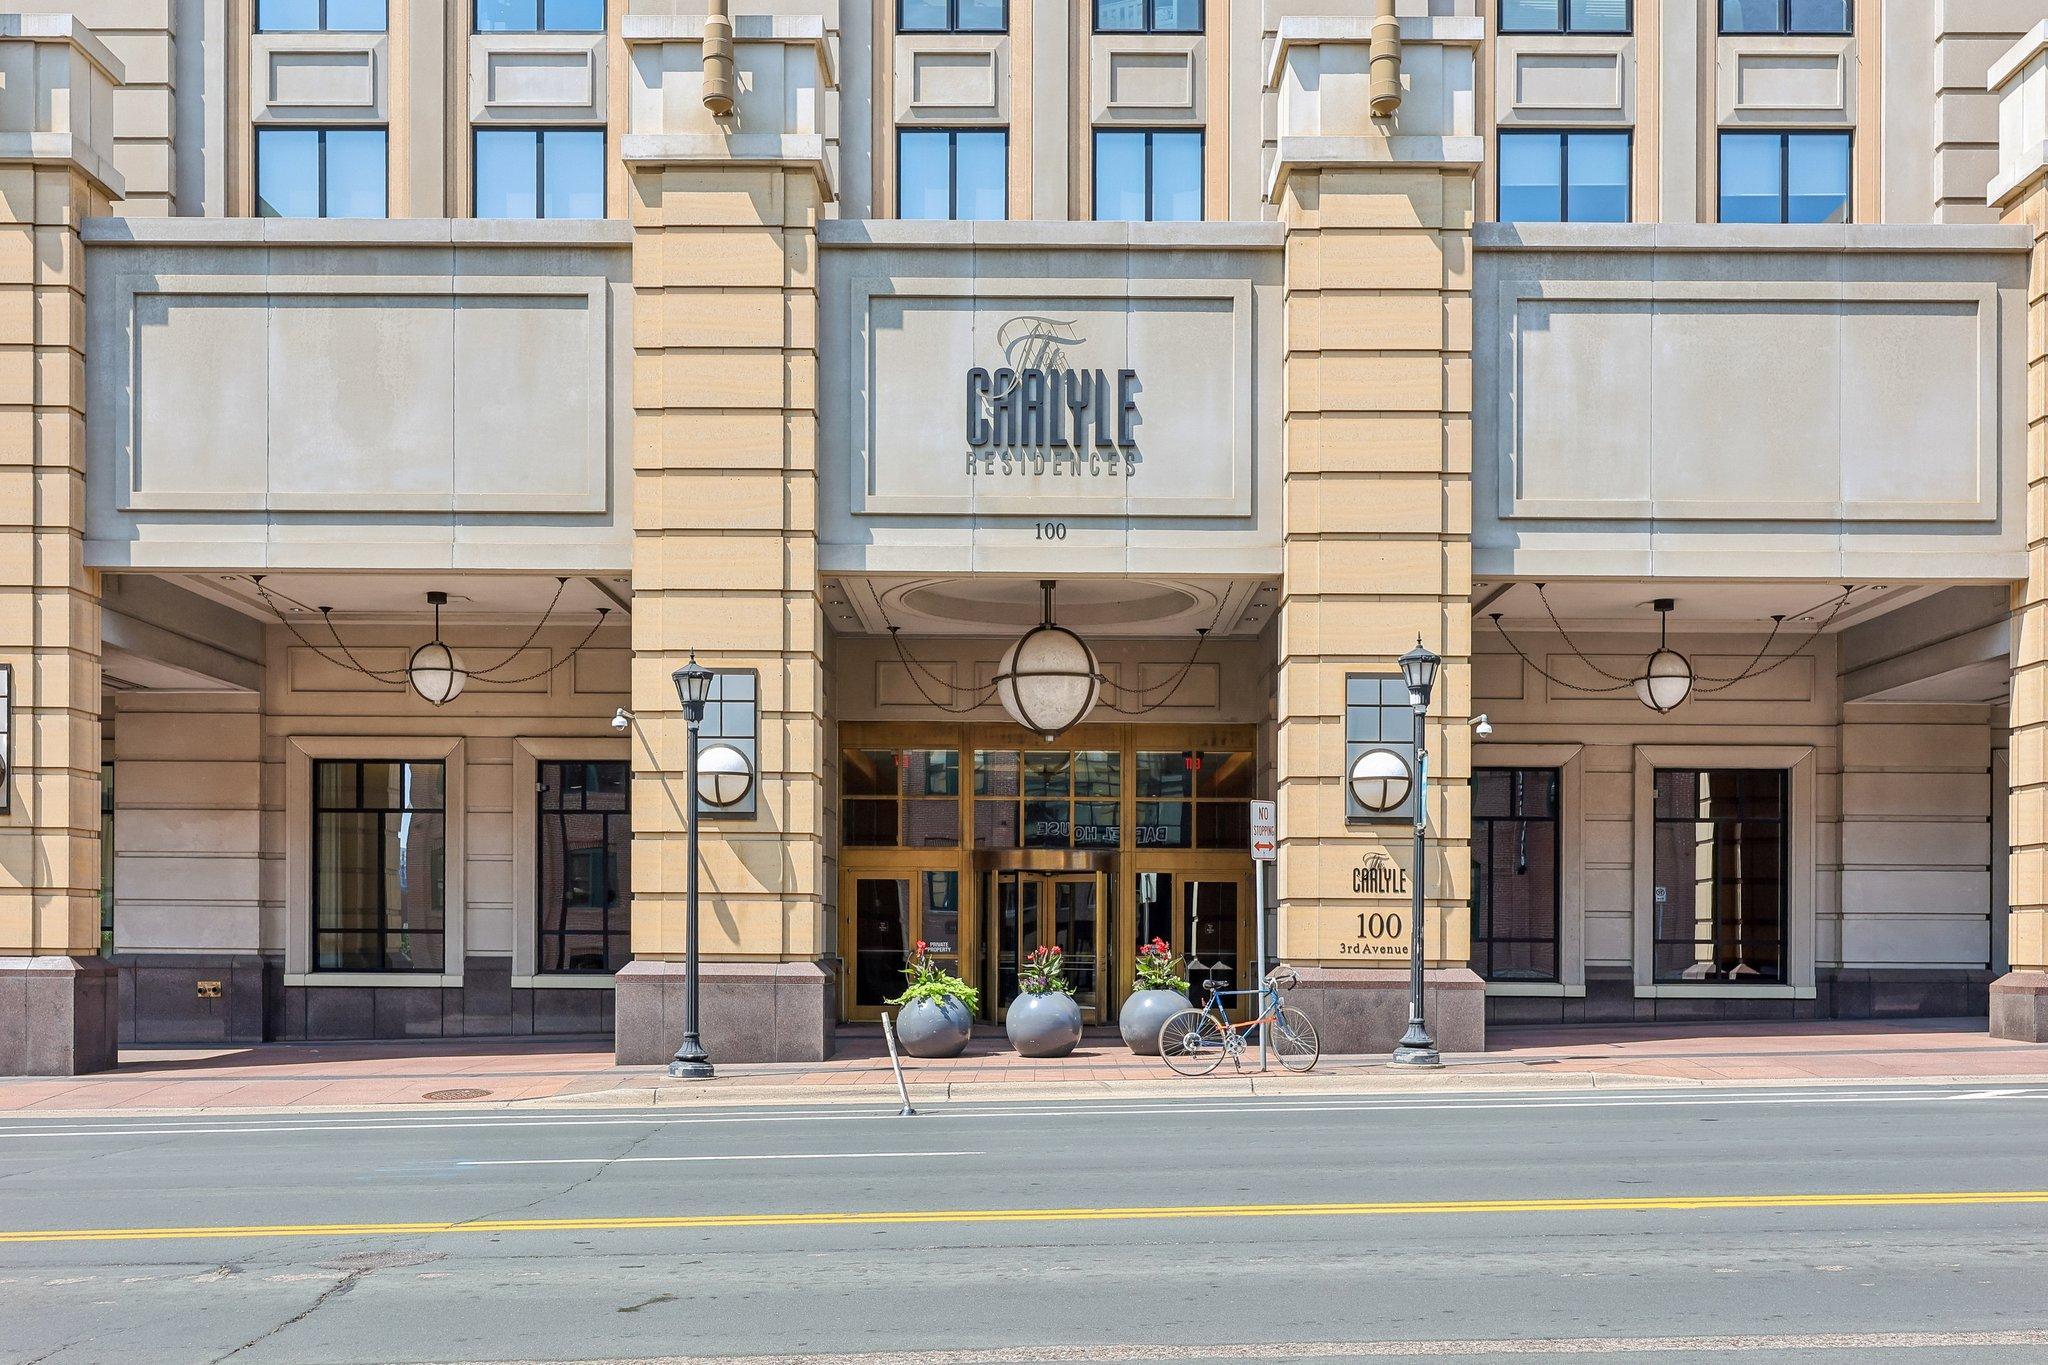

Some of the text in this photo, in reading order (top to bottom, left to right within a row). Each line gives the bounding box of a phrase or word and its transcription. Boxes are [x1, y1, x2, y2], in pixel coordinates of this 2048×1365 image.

[982, 316, 1087, 398] The
[967, 367, 1138, 450] CARLYLE
[965, 451, 1137, 477] RESIDENCES
[1035, 522, 1067, 541] 100
[1258, 806, 1269, 820] NO
[1253, 824, 1275, 837] STOPPING
[1359, 852, 1390, 876] The
[1352, 868, 1407, 894] CARLYLE
[1357, 913, 1402, 939] 100
[1339, 942, 1409, 954] 3rd Avenue
